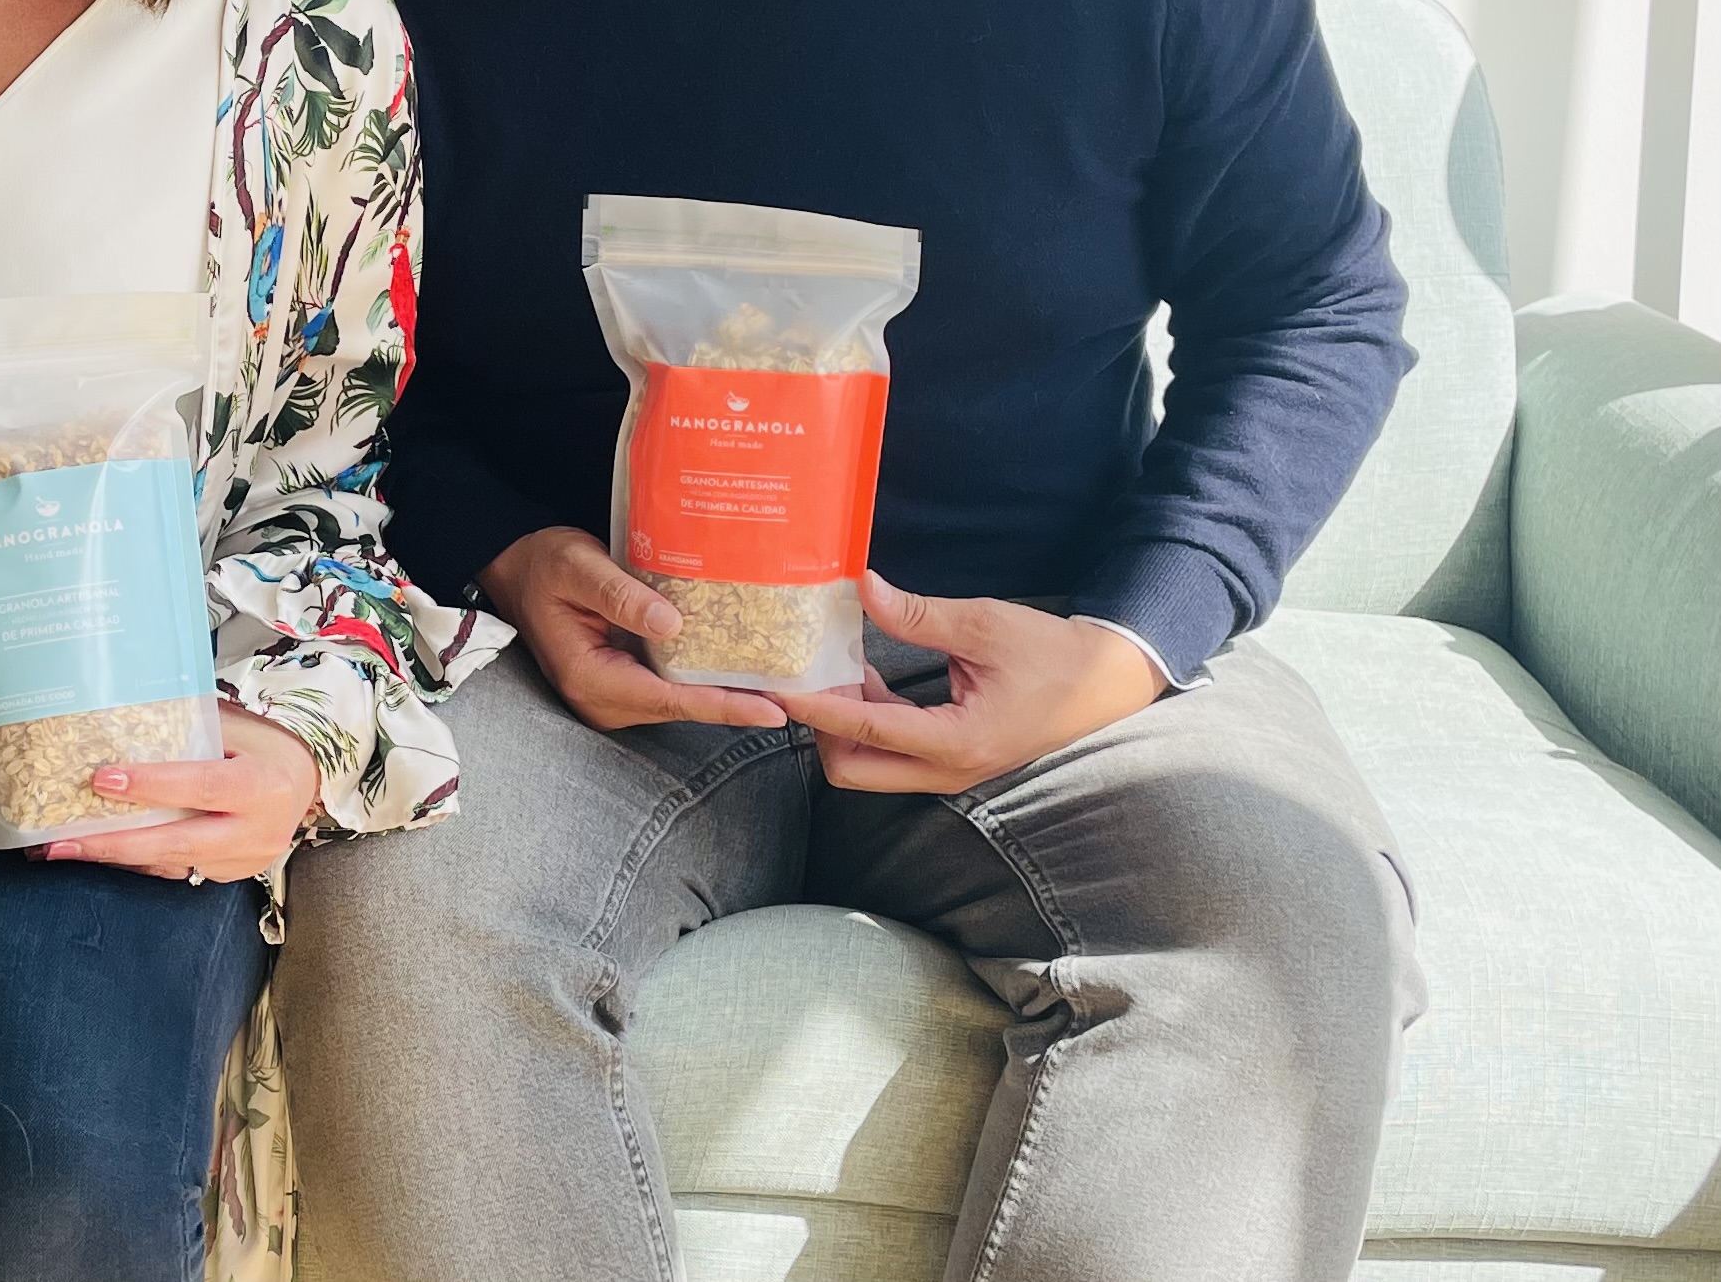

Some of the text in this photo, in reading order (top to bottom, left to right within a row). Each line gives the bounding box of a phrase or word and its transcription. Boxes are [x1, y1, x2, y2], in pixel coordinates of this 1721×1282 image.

[670, 416, 805, 435] NANOGRANOLA
[710, 438, 763, 449] Hand made
[680, 475, 791, 492] GRANOLA ARTESANAL
[681, 498, 786, 515] DE PRIMERA CALIDAD
[24, 545, 83, 562] Hand made
[2, 614, 120, 642] DE PRIMERA CALIDAD
[35, 694, 47, 705] DE
[48, 689, 76, 701] COCO
